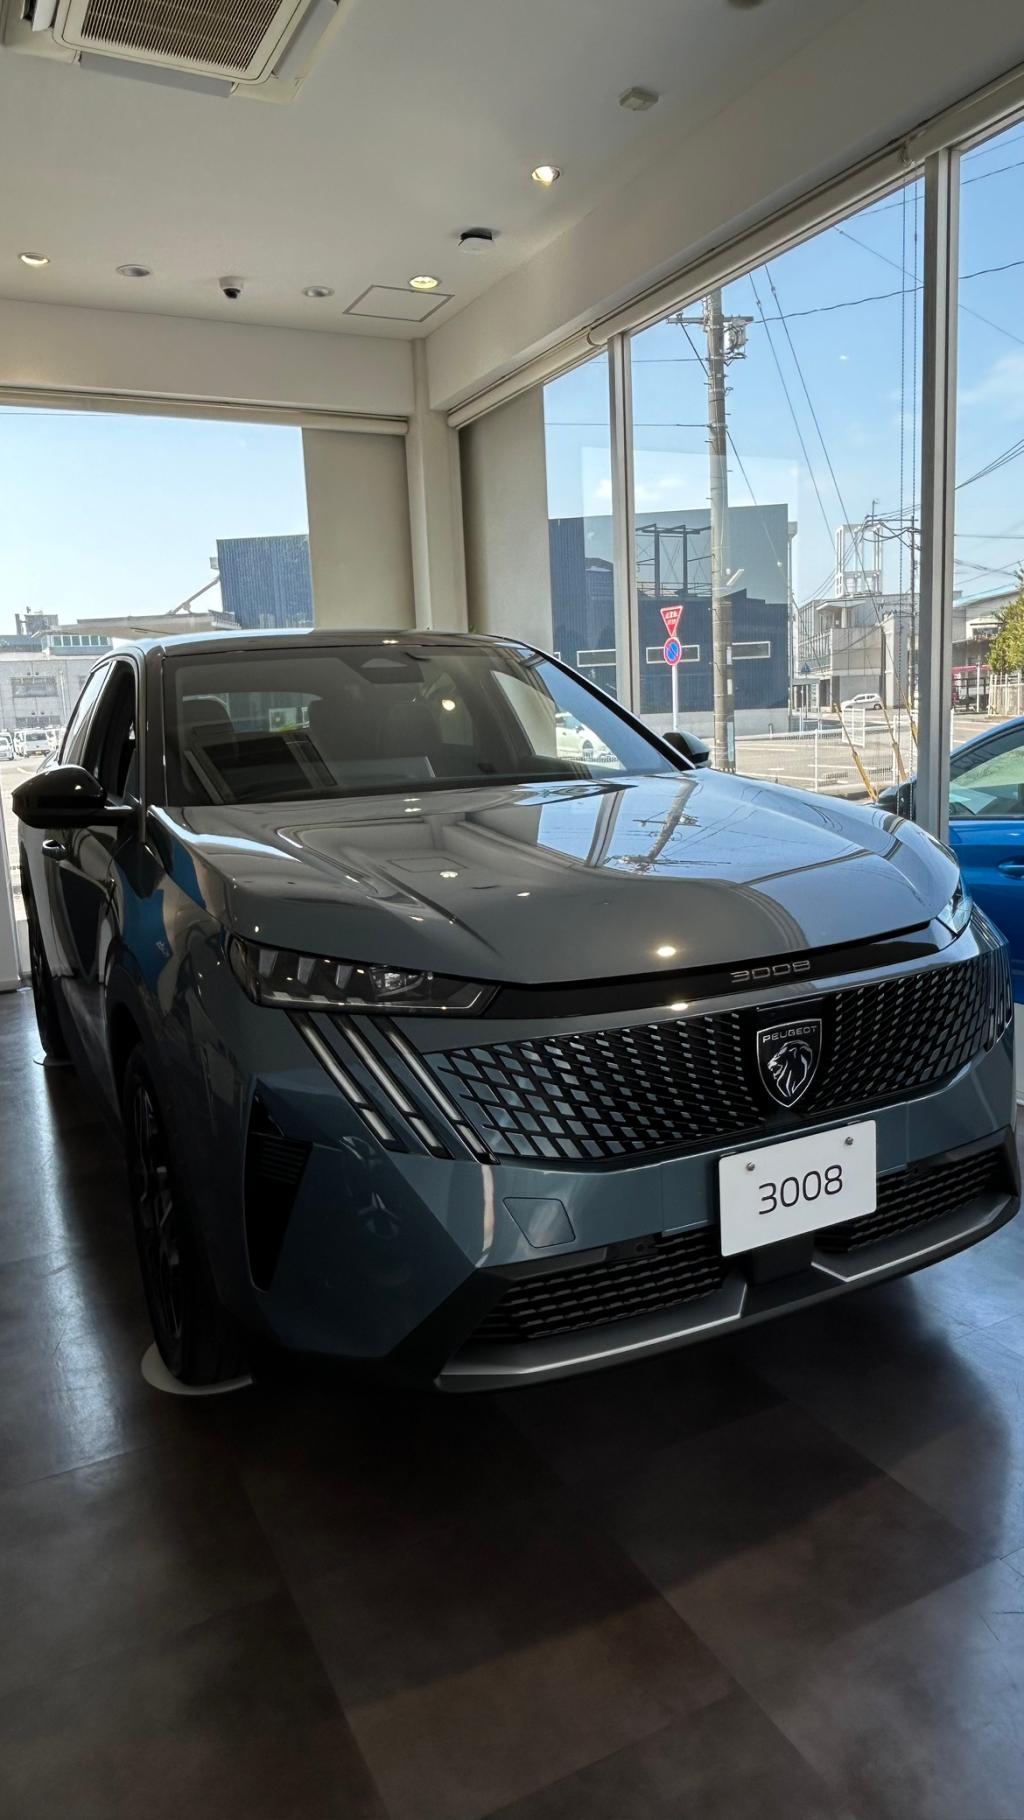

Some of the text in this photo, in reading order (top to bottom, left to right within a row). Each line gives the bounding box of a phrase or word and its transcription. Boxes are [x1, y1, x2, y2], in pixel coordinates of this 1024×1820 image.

[730, 960, 811, 983] 3008
[762, 1025, 817, 1043] PEUGEOT
[758, 1164, 843, 1215] 3008
